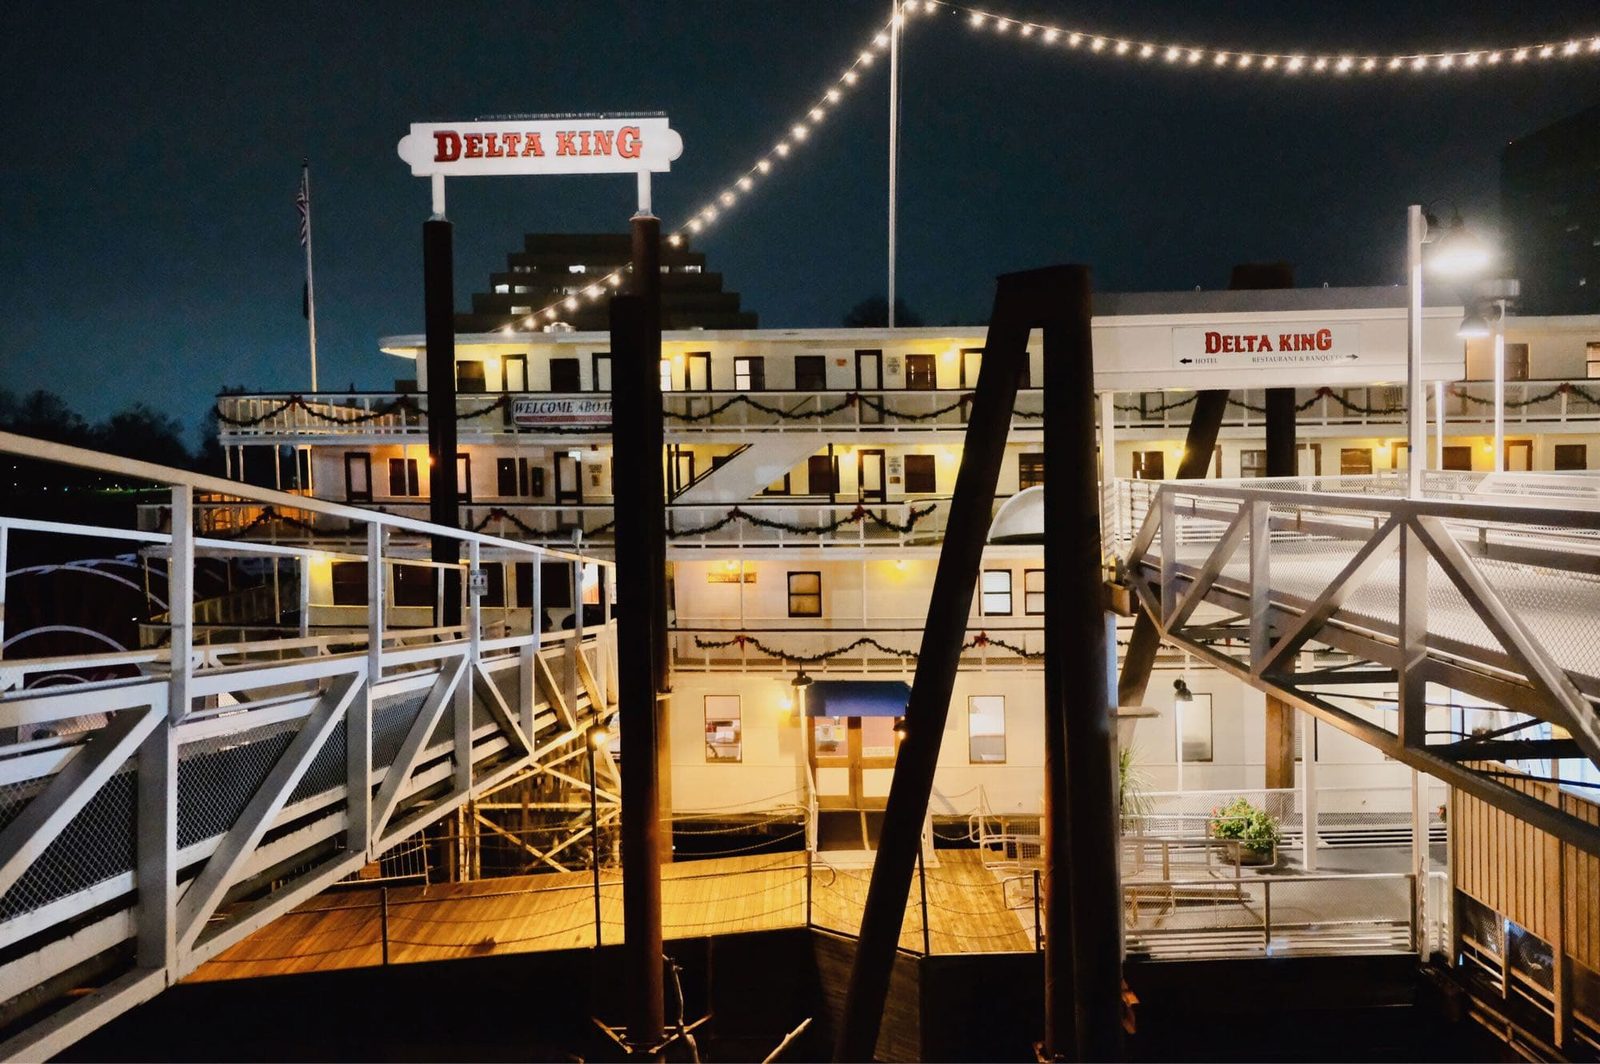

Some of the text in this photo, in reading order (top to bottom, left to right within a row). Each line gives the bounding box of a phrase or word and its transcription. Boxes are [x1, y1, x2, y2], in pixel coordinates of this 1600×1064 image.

[433, 125, 643, 162] DELTA KING
[1204, 329, 1332, 353] DELTA KING
[1195, 357, 1218, 365] HOTEL
[1252, 354, 1297, 363] RESTAURANT
[514, 402, 573, 413] WELCOME
